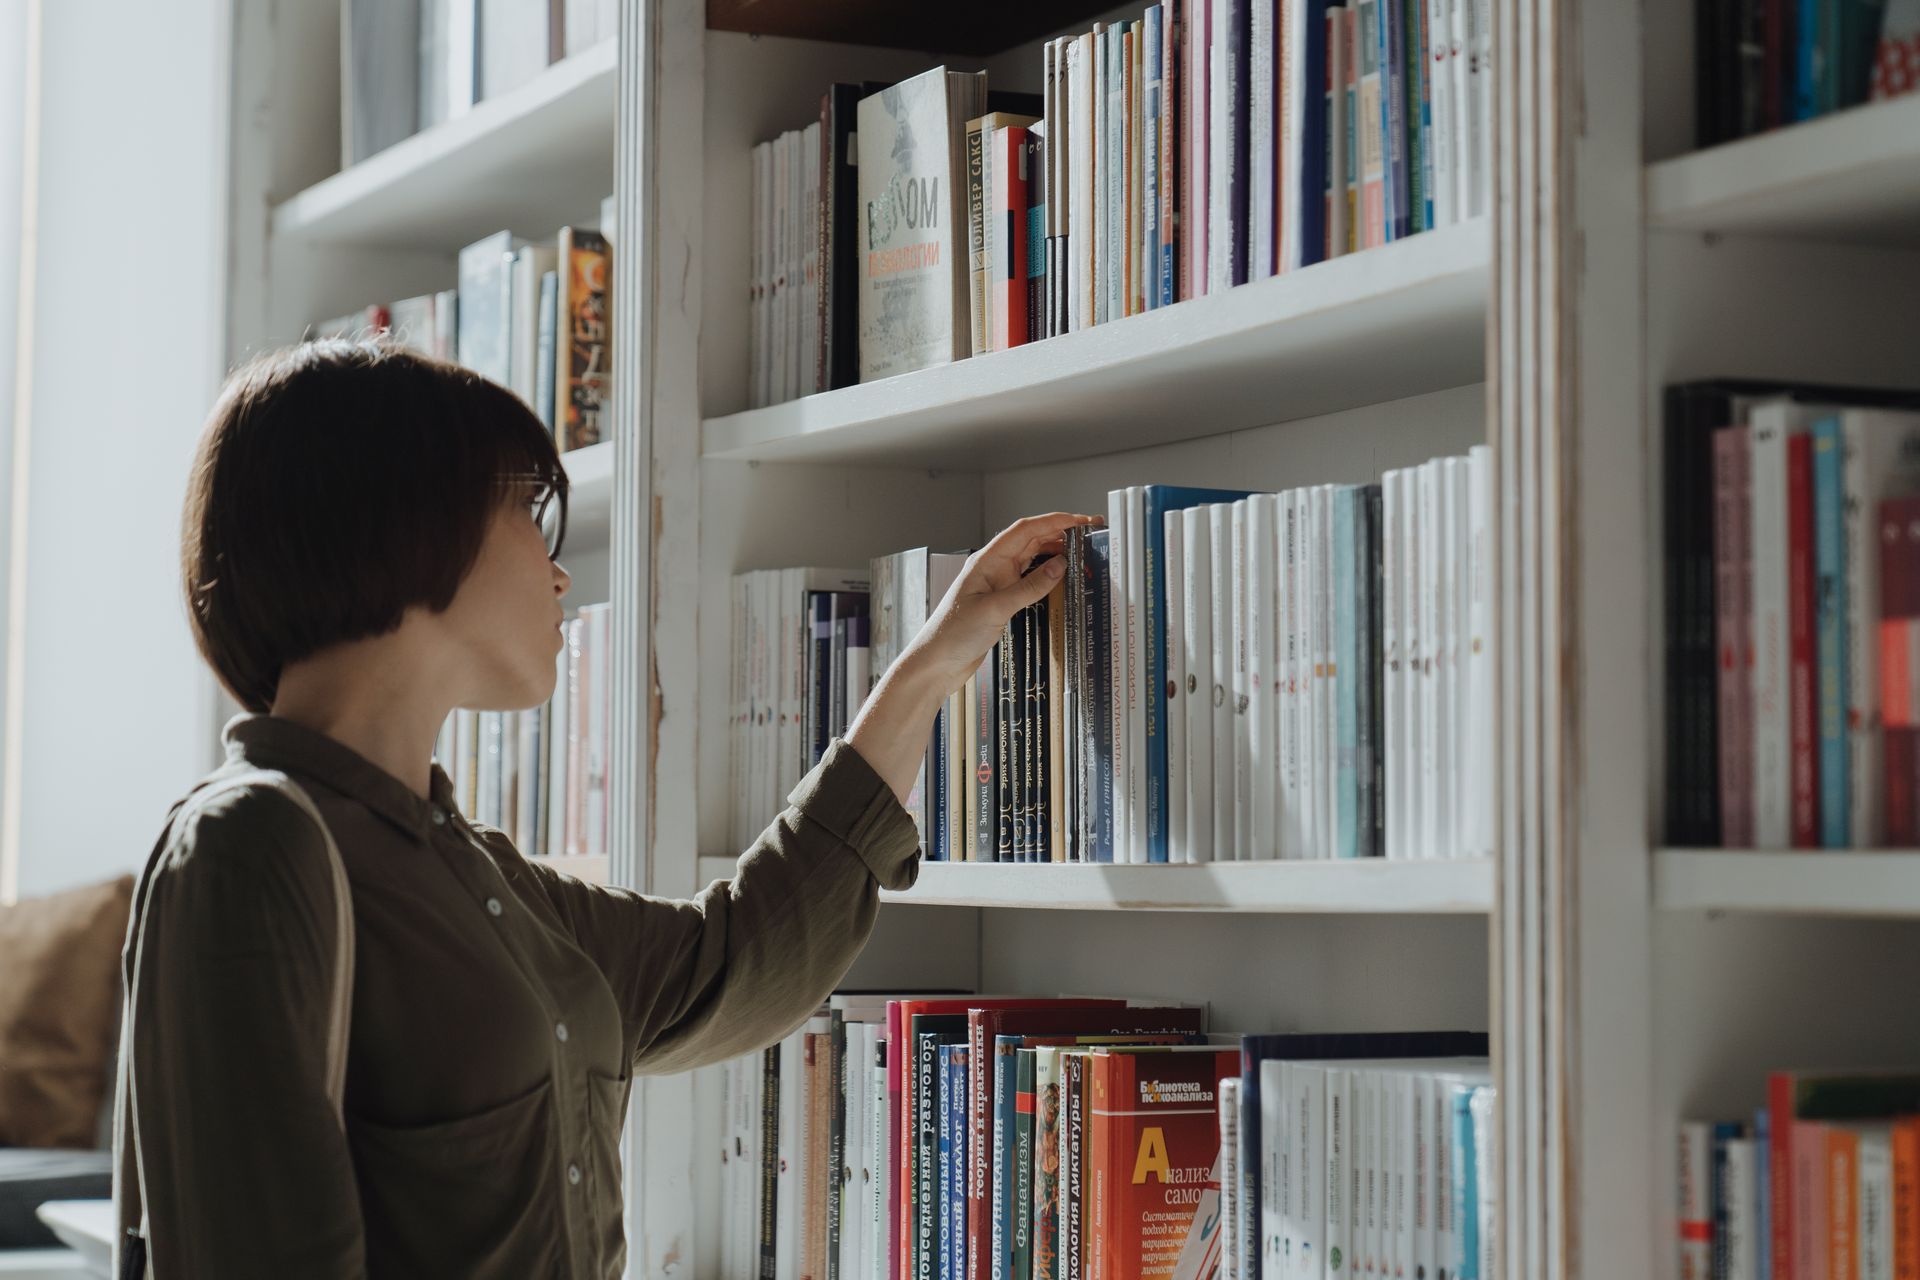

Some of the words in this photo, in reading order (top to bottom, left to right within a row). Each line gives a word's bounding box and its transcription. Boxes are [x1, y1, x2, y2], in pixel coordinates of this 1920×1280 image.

[971, 136, 981, 176] САКС
[973, 183, 983, 245] ОЛИВЕР
[1111, 536, 1120, 637] ПСИХОЛОГИЯ
[1146, 547, 1155, 670] ПСИХОТЕРАПИИ
[1086, 630, 1095, 667] Театры
[1128, 604, 1136, 710] ПСИХОЛОГИЯ
[1114, 641, 1122, 778] ИНДИВИДУАЛЬНАЯ
[1147, 673, 1155, 737] ИСТОКИ
[976, 745, 993, 784] Фрейд
[1001, 763, 1009, 790] Эрих
[1088, 736, 1097, 771] Джойс
[979, 785, 989, 827] Зигмунд
[922, 1039, 935, 1134] разговор
[940, 1055, 950, 1140] ДИСКУРС
[975, 1024, 988, 1114] практики
[1140, 1080, 1201, 1093] Библиотека
[1142, 1091, 1214, 1103] психоанализа
[976, 1117, 985, 1130] и
[1070, 1094, 1082, 1198] диктатуры
[953, 1120, 964, 1197] ДИАЛОГ
[975, 1134, 988, 1200] теории
[1132, 1127, 1210, 1184] Анализ
[1015, 1130, 1029, 1249] Фанатизм
[1095, 1169, 1103, 1201] самости
[1165, 1187, 1201, 1205] само
[1095, 1201, 1103, 1228] Анализ
[1142, 1224, 1167, 1236] подход
